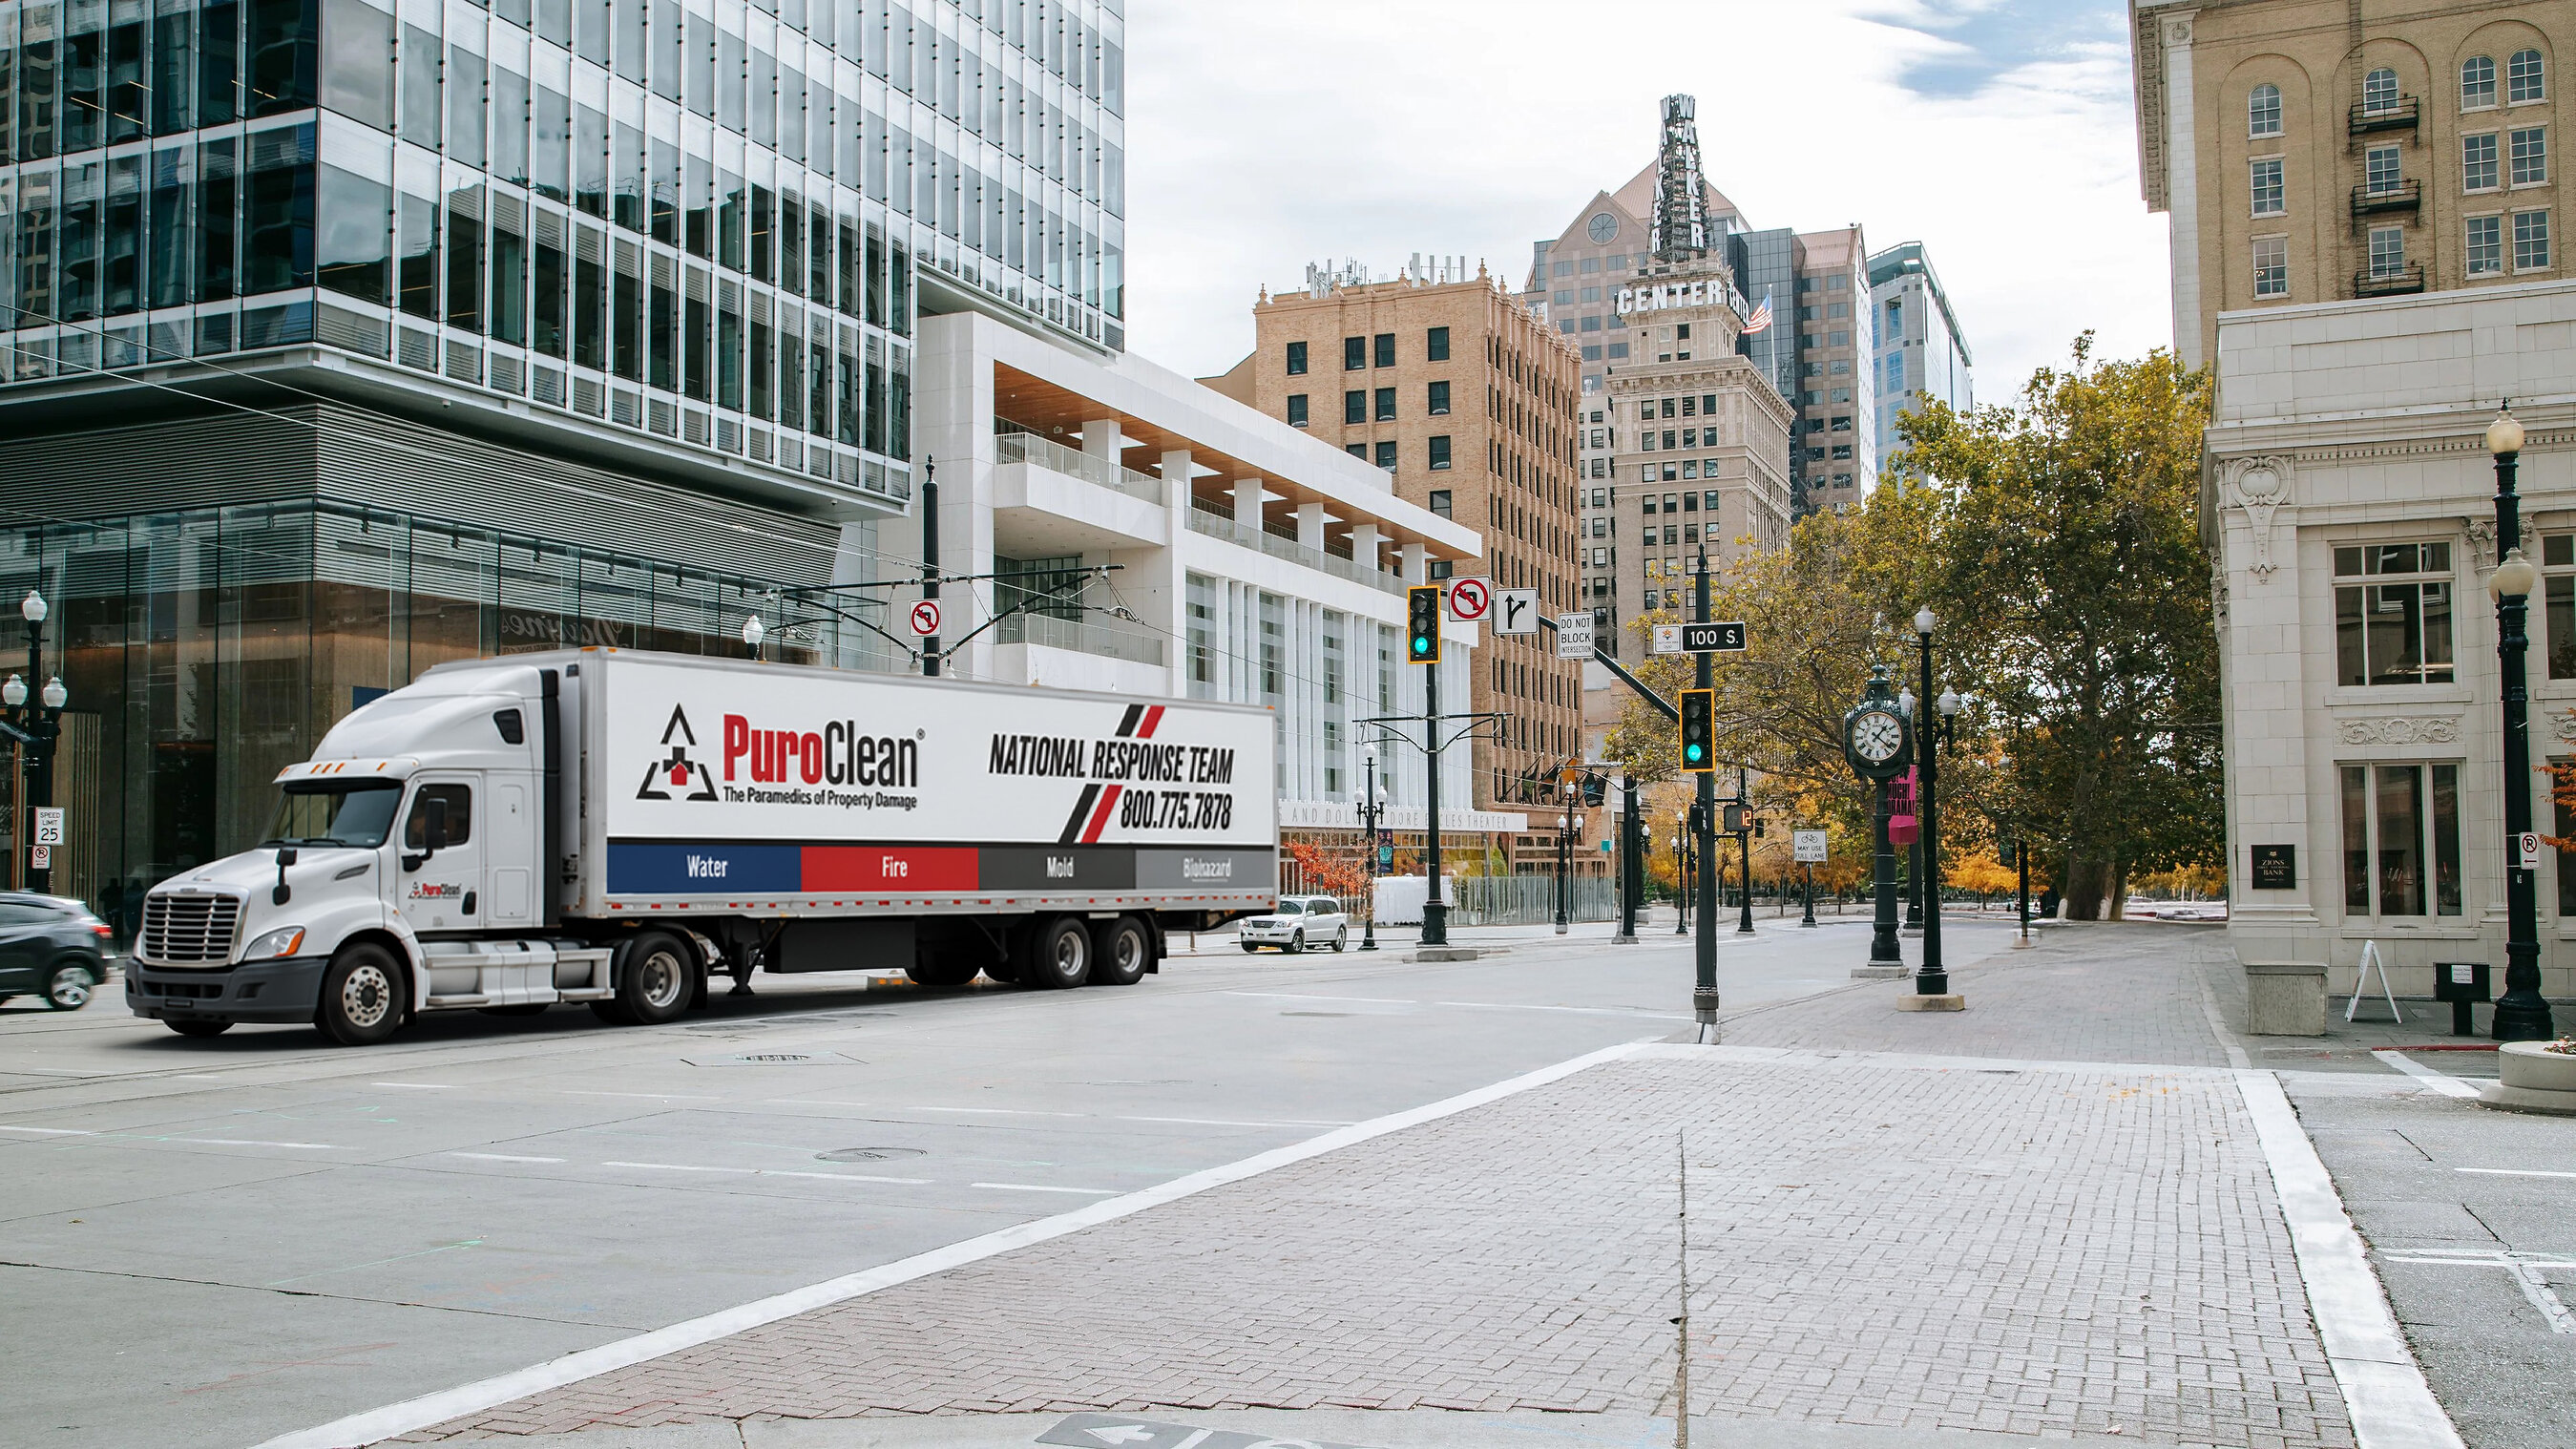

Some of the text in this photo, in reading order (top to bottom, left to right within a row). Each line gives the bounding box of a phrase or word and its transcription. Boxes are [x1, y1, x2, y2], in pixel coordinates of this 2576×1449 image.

[1651, 95, 1671, 254] WALKER
[1677, 93, 1705, 248] WALKER
[1617, 280, 1723, 314] CENTER
[1560, 617, 1591, 629] DO NOT
[1560, 632, 1591, 643] BLOCK
[1690, 629, 1739, 645] 100 S.
[723, 713, 917, 788] PuroClean
[989, 733, 1235, 784] NATIONAL RESPONSE TEAM
[723, 787, 917, 811] The Paramedics of Property Damage
[1120, 789, 1233, 830] 800.775.7878
[1292, 807, 1317, 823] AND
[1326, 808, 1382, 825] DOLOS
[1425, 813, 1462, 827] ECLES
[1468, 814, 1507, 829] THEATER
[1742, 810, 1752, 827] 12
[41, 828, 58, 841] 25
[686, 854, 728, 877] Water
[882, 855, 908, 877] Fire
[1046, 856, 1074, 878] Mold
[1183, 857, 1231, 878] Biohazard
